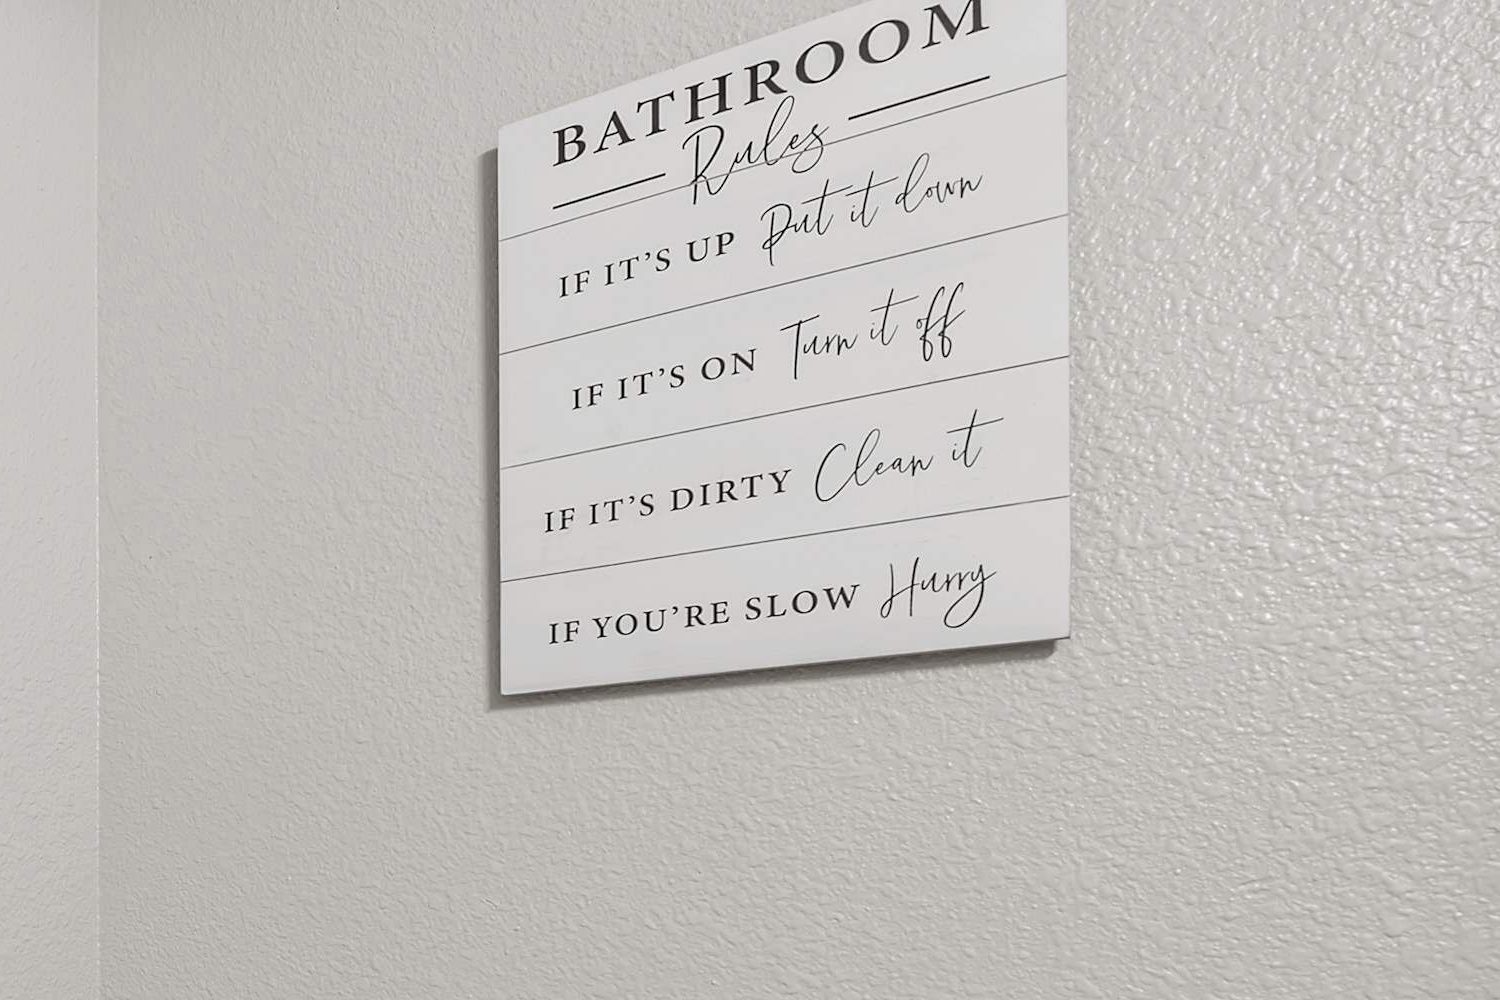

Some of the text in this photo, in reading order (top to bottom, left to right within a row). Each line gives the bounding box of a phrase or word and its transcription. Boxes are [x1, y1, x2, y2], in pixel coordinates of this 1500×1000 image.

[551, 0, 992, 168] BATHROOM
[682, 94, 830, 206] Rules
[559, 152, 984, 299] IF IT’S UP Put it down
[572, 281, 966, 411] IF IT’S ON Turn it off
[543, 409, 1004, 534] IF IT’S DIRTY Clean it
[548, 556, 997, 645] IF YOU’RE SLOW Hurry
